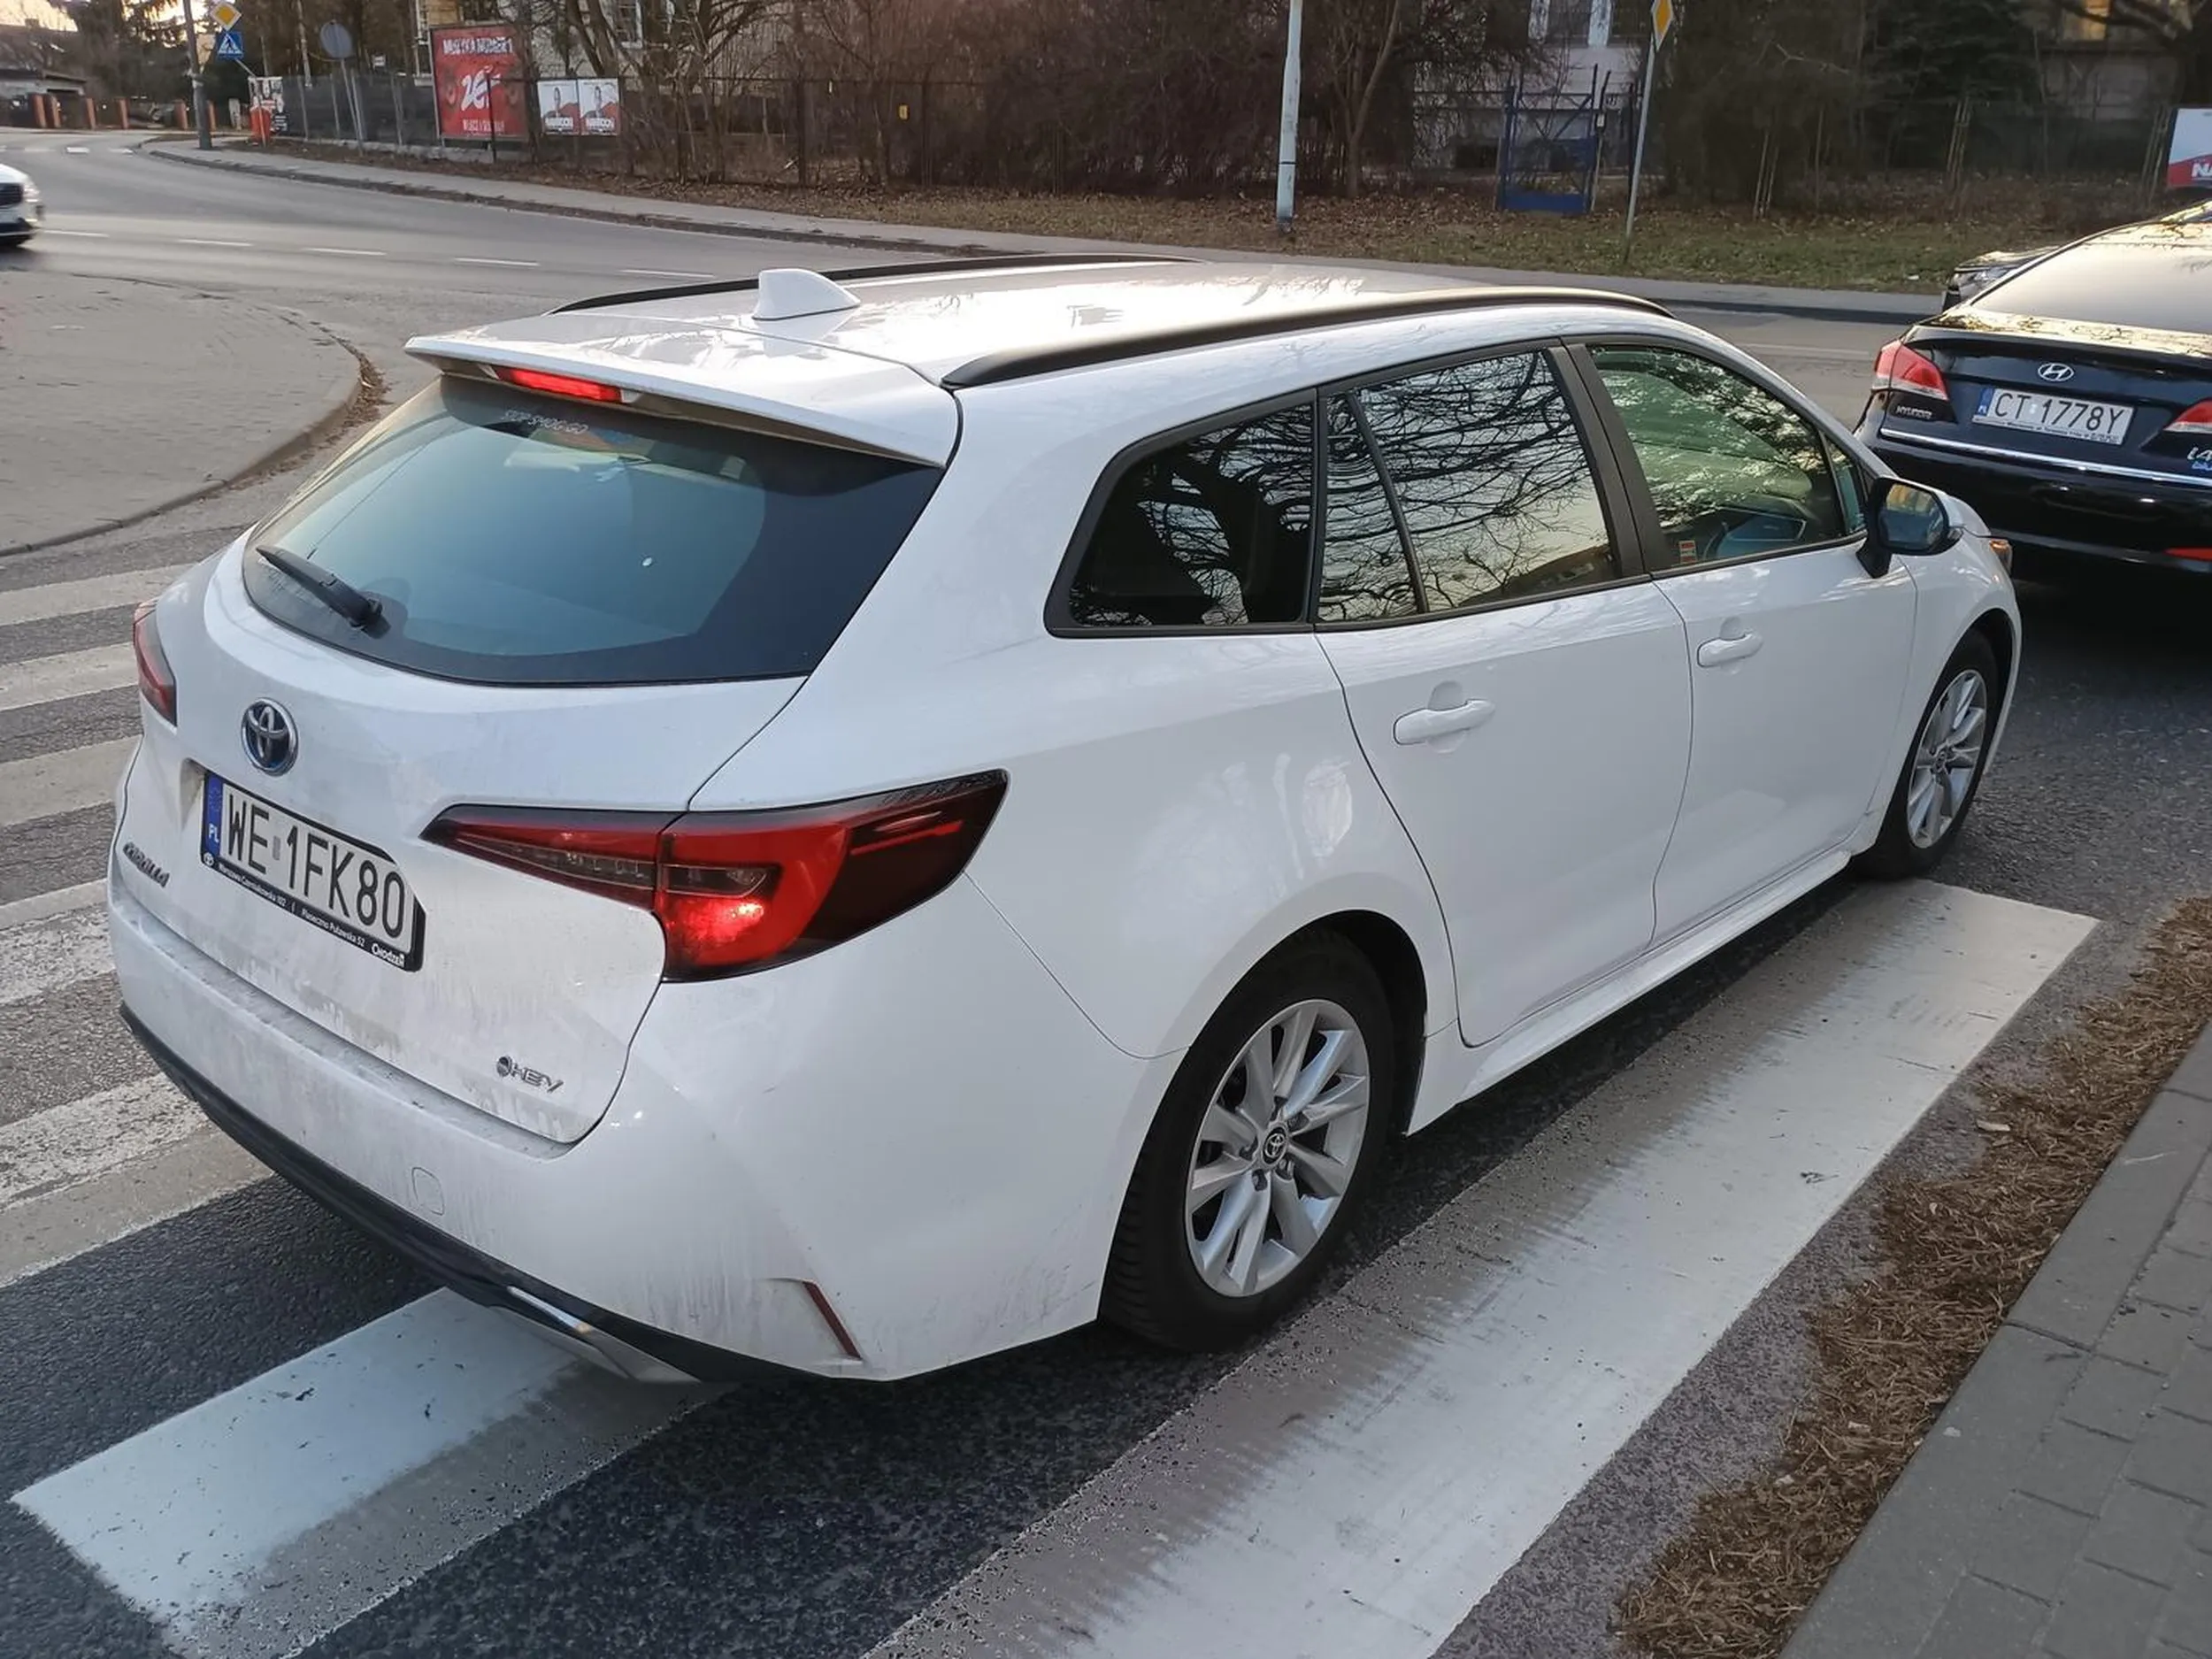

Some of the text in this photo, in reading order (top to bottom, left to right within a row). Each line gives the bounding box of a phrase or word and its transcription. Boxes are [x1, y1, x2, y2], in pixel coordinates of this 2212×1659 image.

[1895, 405, 1932, 419] HYUNDAI
[1994, 392, 2124, 434] CT 1778Y
[208, 822, 220, 843] PL
[228, 794, 405, 939] WE 1FK80
[511, 1062, 565, 1094] HEV
